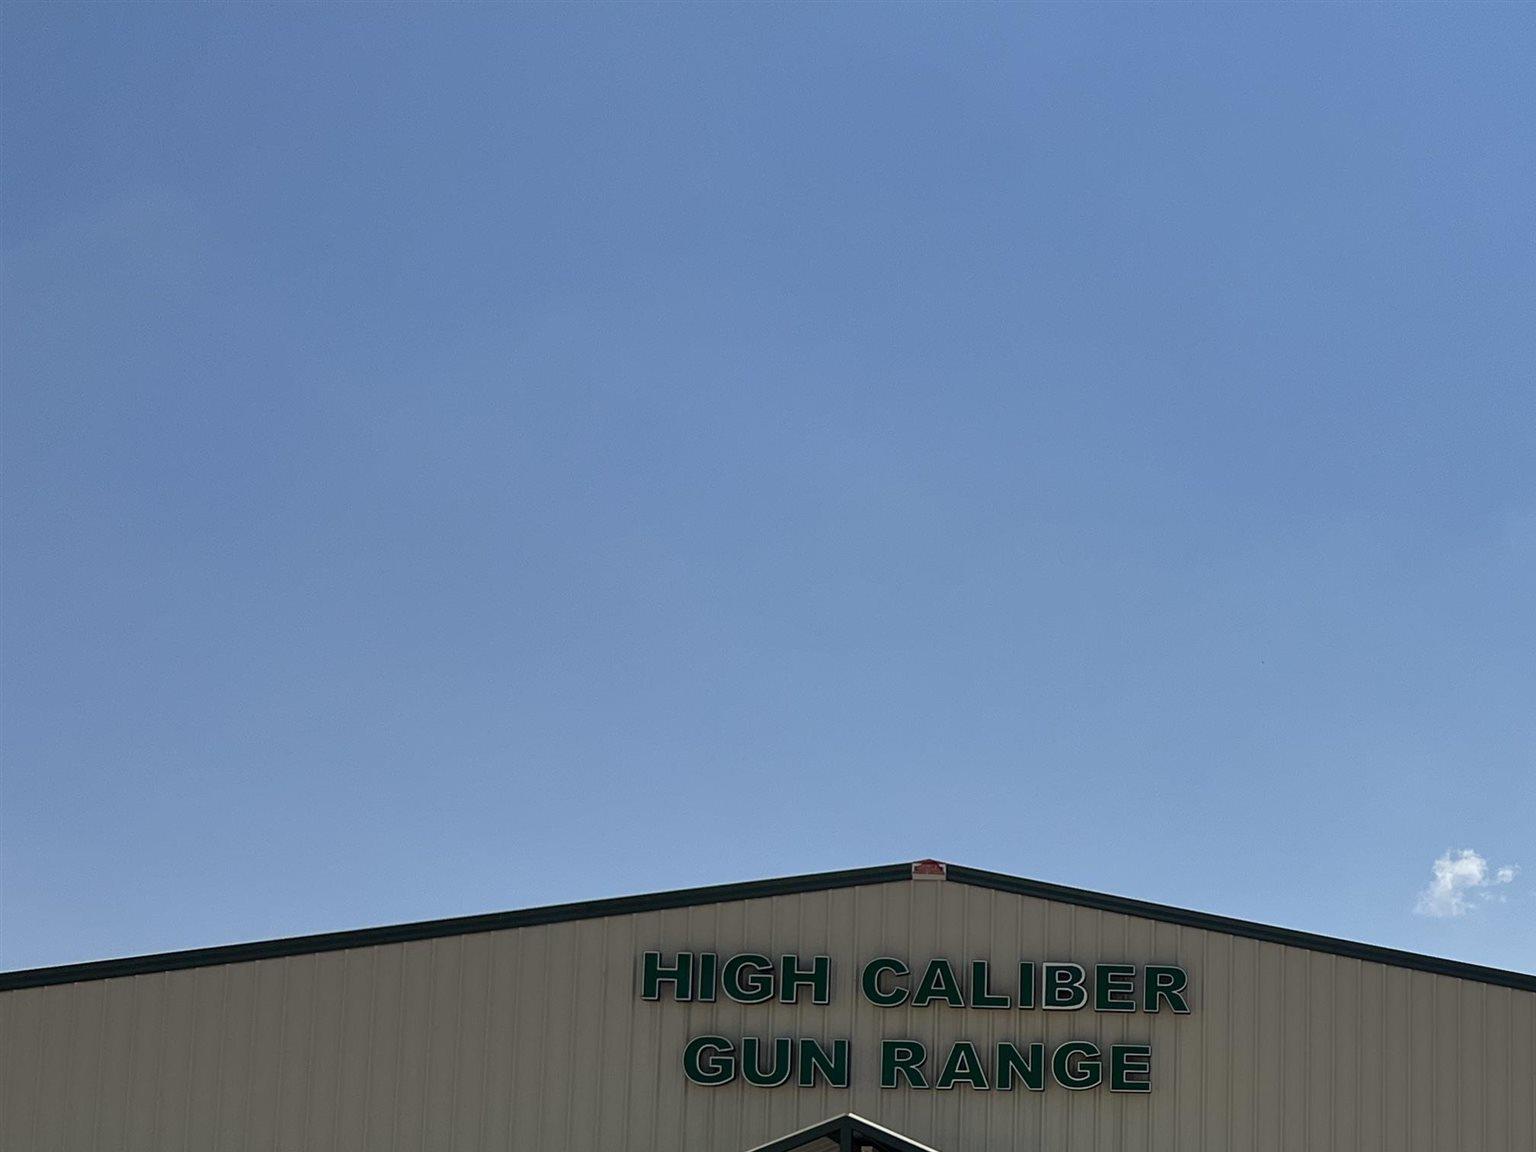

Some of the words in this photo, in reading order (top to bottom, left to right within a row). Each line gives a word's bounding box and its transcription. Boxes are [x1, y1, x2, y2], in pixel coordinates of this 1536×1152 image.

[641, 950, 831, 1006] HIGH
[861, 956, 1192, 1015] CALIBER
[682, 1035, 850, 1089] GUN
[880, 1039, 1152, 1094] RANGE
